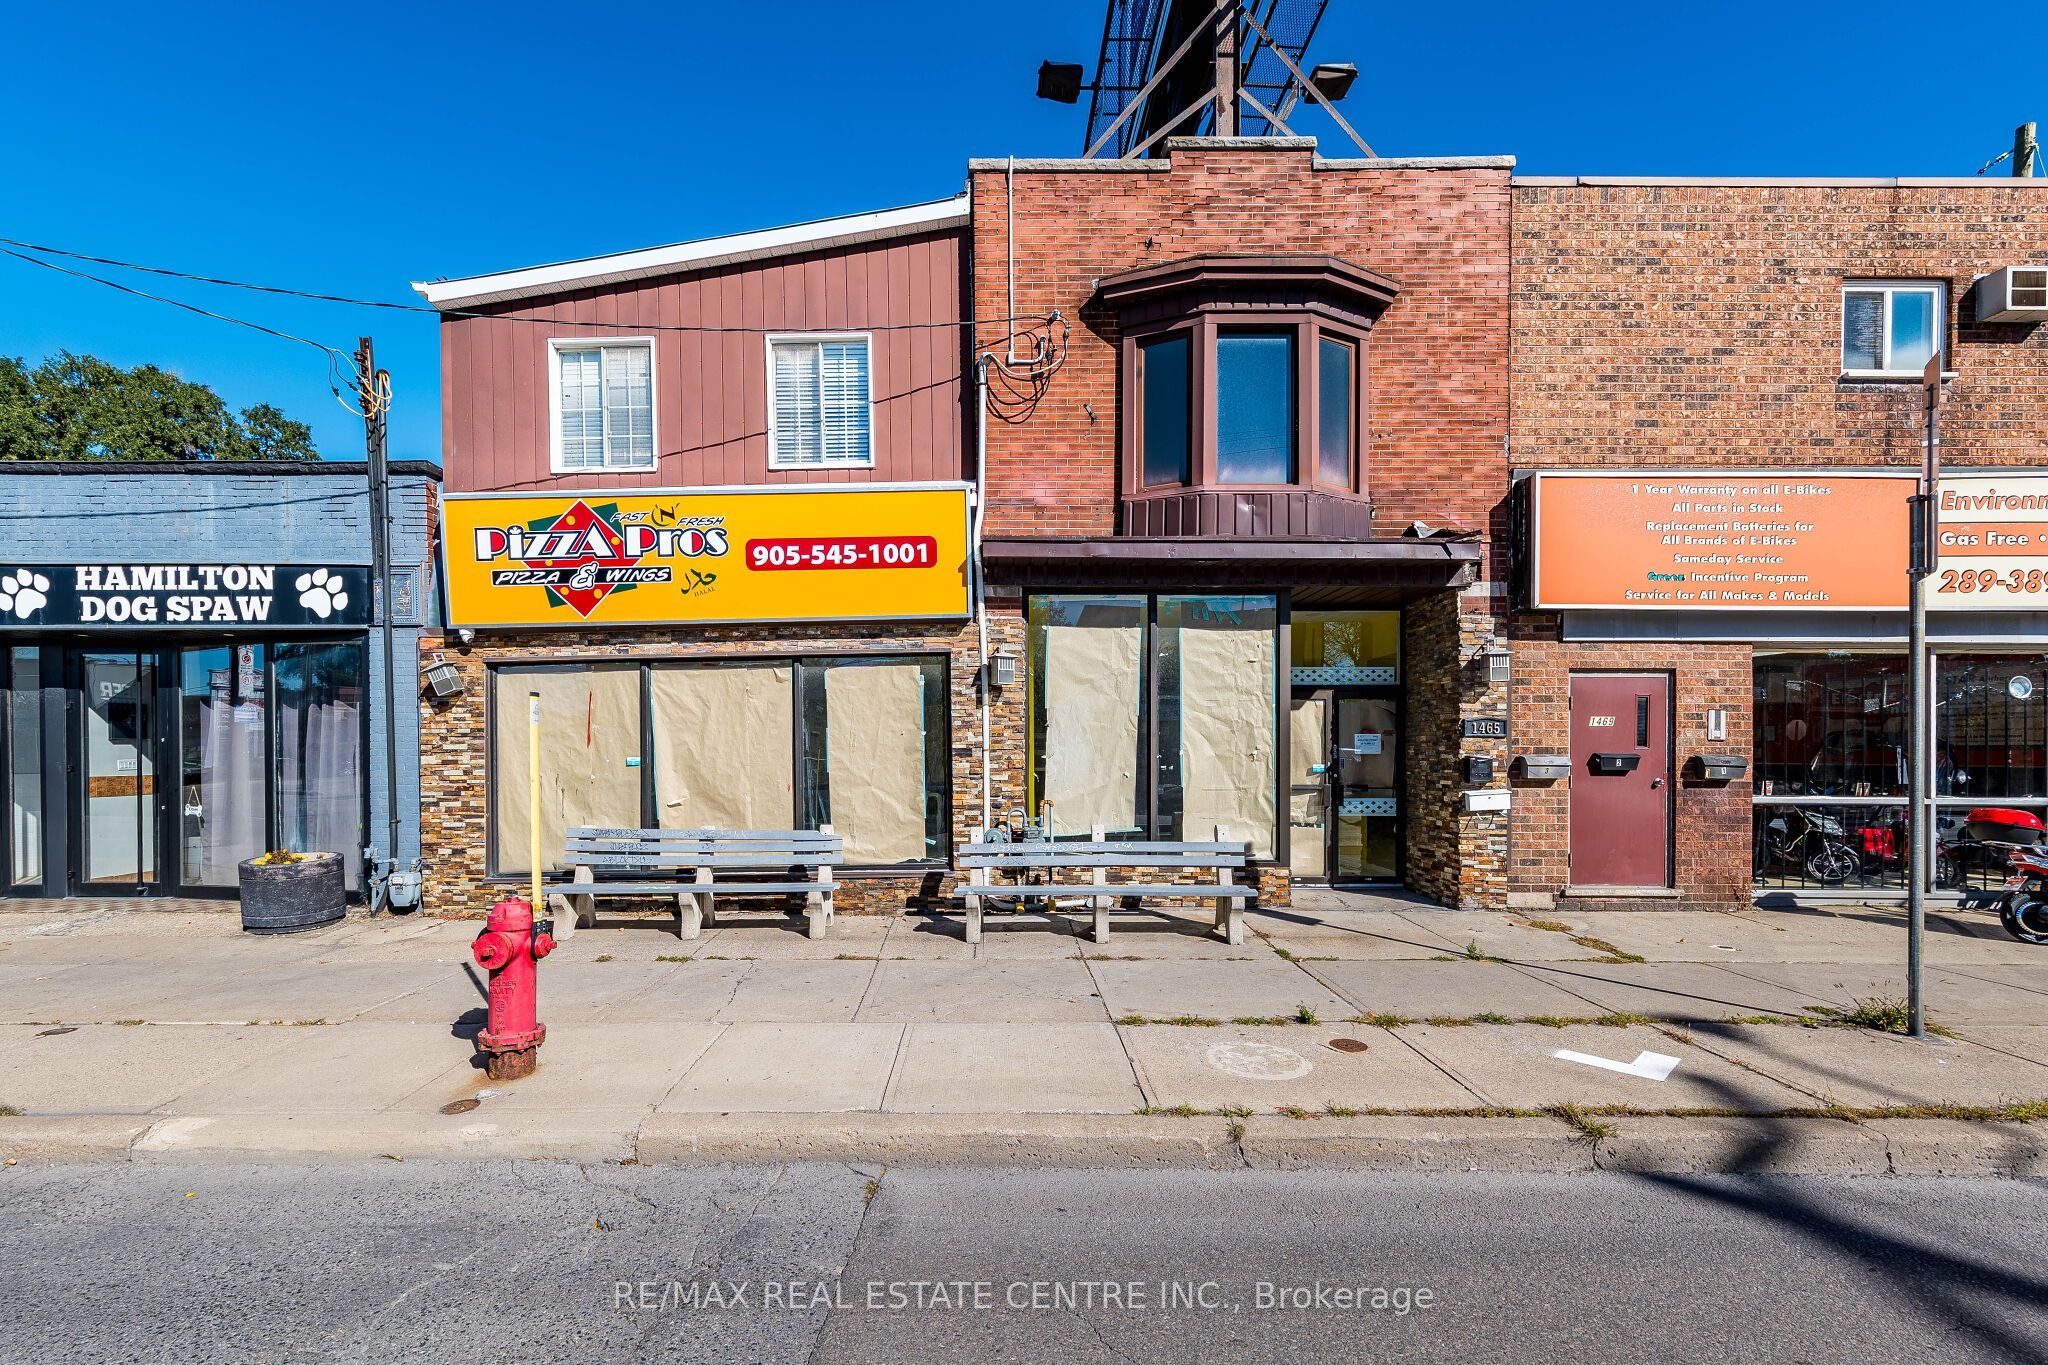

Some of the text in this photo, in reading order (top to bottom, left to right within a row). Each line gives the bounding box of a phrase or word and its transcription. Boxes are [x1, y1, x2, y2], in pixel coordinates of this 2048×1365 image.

[1632, 484, 1832, 497] 1 Year Warranty on all E-Bikes
[1672, 503, 1784, 513] All Parts in Stock
[610, 511, 650, 522] FAST
[676, 516, 725, 527] FRESH
[1646, 521, 1814, 532] Replacement Batteries for
[623, 523, 729, 558] Pros
[1661, 535, 1798, 546] All Brands of E-Bikes
[1940, 531, 2029, 546] Gas Free
[752, 543, 928, 566] 905-545-1001
[1673, 553, 1784, 565] Sameday Service
[75, 565, 275, 590] HAMILTON
[495, 561, 670, 590] PIZZA & WINGS
[1647, 571, 1809, 584] Green Incentive Program
[1938, 569, 2048, 593] 289-38
[694, 587, 716, 598] HALAL
[1625, 589, 1830, 601] Service for All Makes & Models
[80, 596, 273, 622] DOG SPAW
[1472, 722, 1500, 734] 1465
[1590, 717, 1614, 726] 1469
